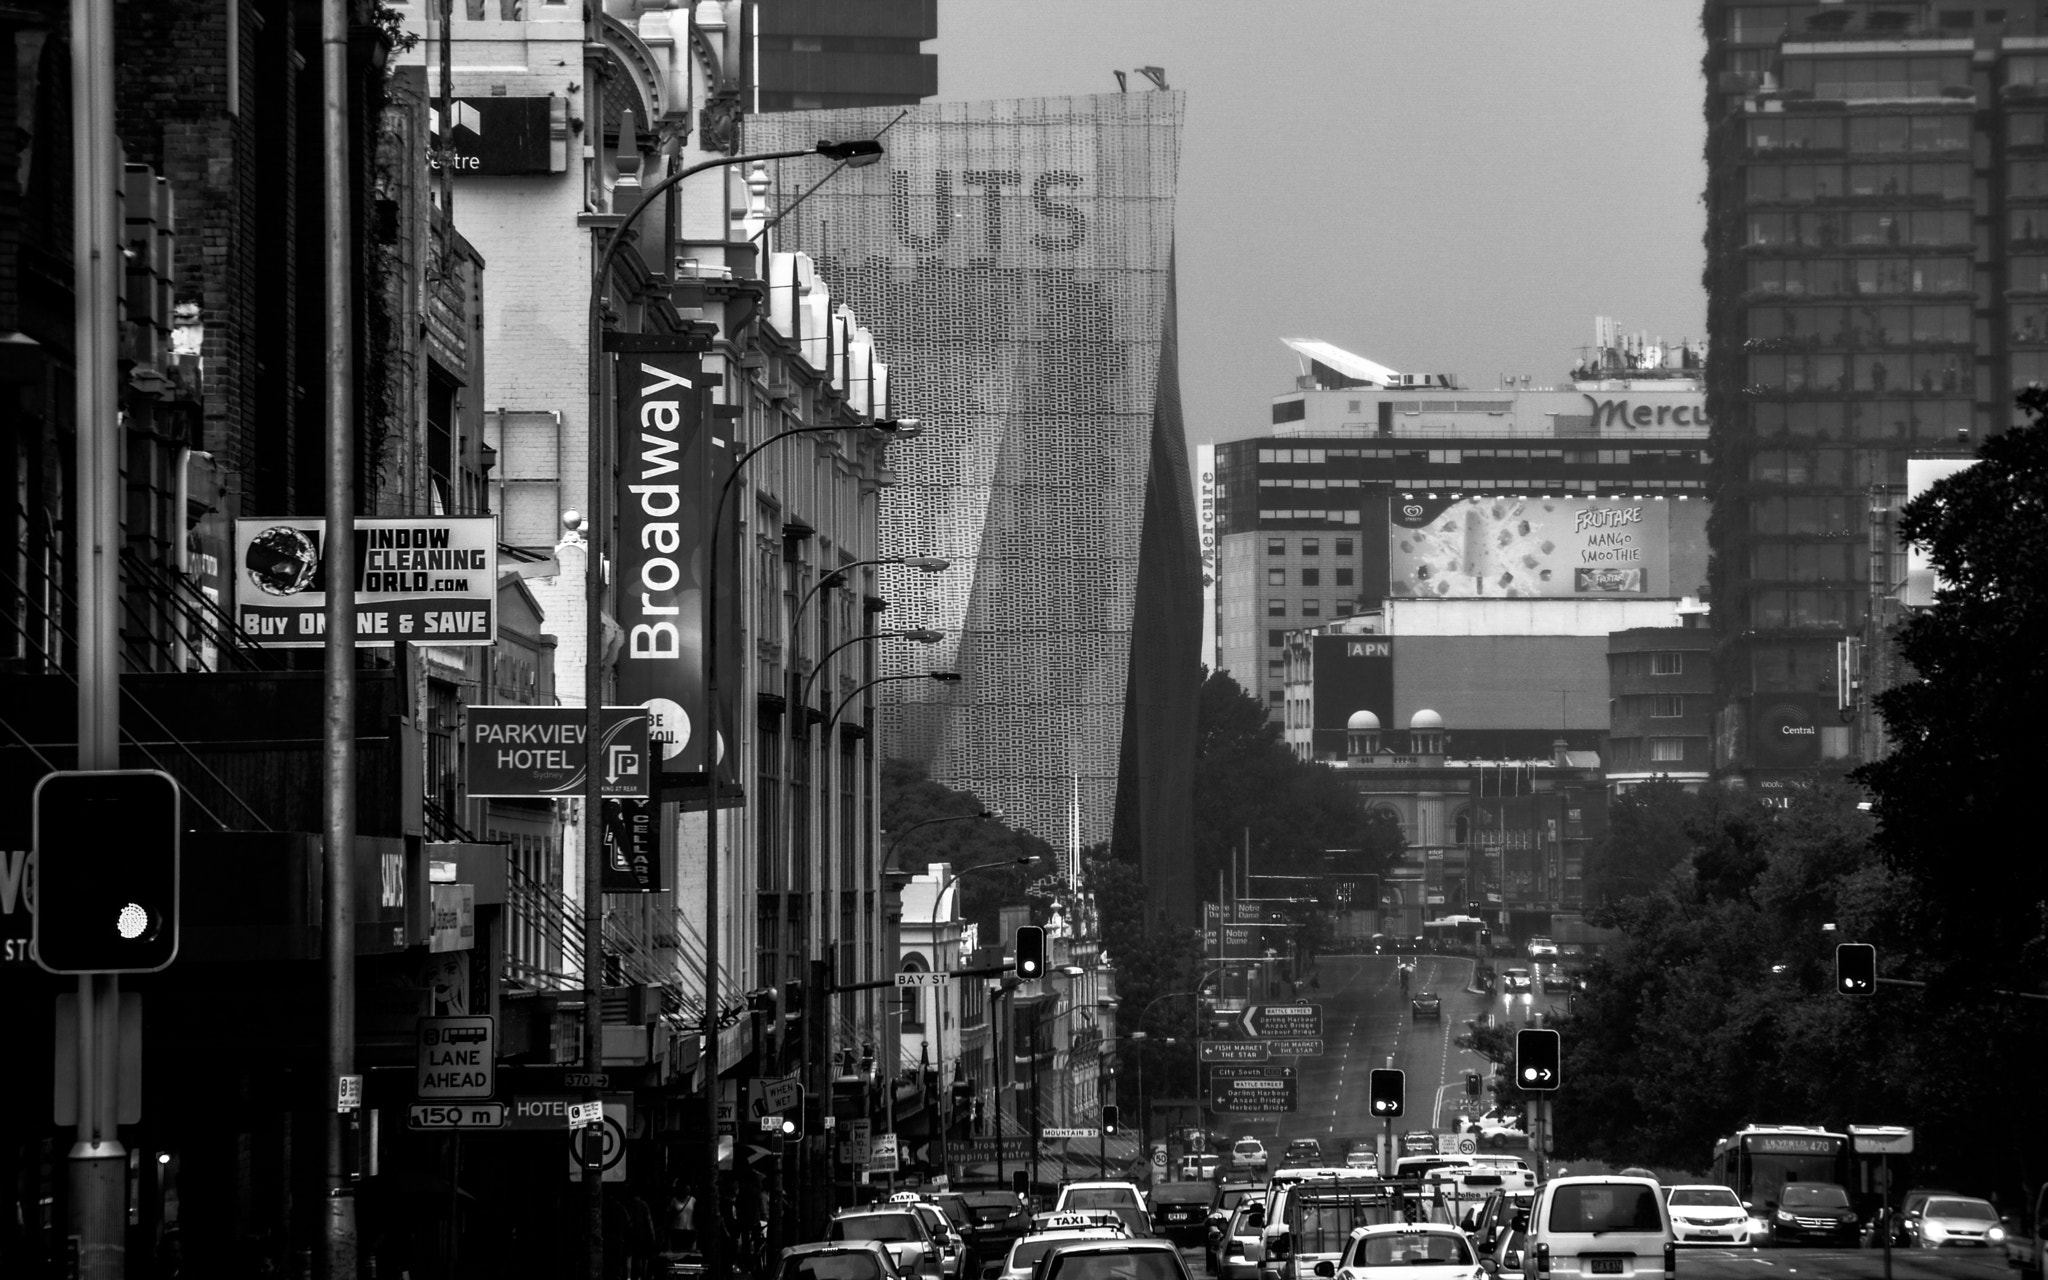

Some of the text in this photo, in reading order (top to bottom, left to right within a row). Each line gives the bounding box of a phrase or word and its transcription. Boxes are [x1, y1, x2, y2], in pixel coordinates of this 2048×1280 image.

[891, 170, 1085, 251] UTS
[629, 362, 693, 660] Broadway
[1202, 472, 1215, 568] Mercure
[1575, 507, 1642, 533] FRUTTARE
[1588, 533, 1632, 546] MANGO
[368, 549, 485, 570] CLEANING
[1581, 548, 1640, 563] SMOOTHIE
[299, 612, 389, 635] ONNE
[399, 614, 414, 633] &
[424, 611, 486, 634] SAVE
[1352, 643, 1388, 656] APN
[475, 724, 588, 744] PARKVIEW
[1782, 725, 1815, 734] Central
[498, 750, 574, 769] HOTEL
[532, 770, 564, 780] Sydney
[899, 974, 947, 985] BAY ST
[430, 1051, 480, 1065] LANE
[1219, 1068, 1235, 1077] City
[1238, 1068, 1261, 1076] South
[423, 1073, 486, 1088] AHEAD
[567, 1075, 590, 1086] 370
[770, 1085, 793, 1097] WHEN
[775, 1095, 792, 1107] WET
[422, 1107, 462, 1123] 150
[472, 1111, 490, 1123] m
[517, 1101, 569, 1117] HOTEL
[971, 1140, 1023, 1151] Broaway
[1462, 1143, 1473, 1151] 50
[1810, 1141, 1829, 1151] 470
[1054, 1217, 1084, 1226] TAXI
